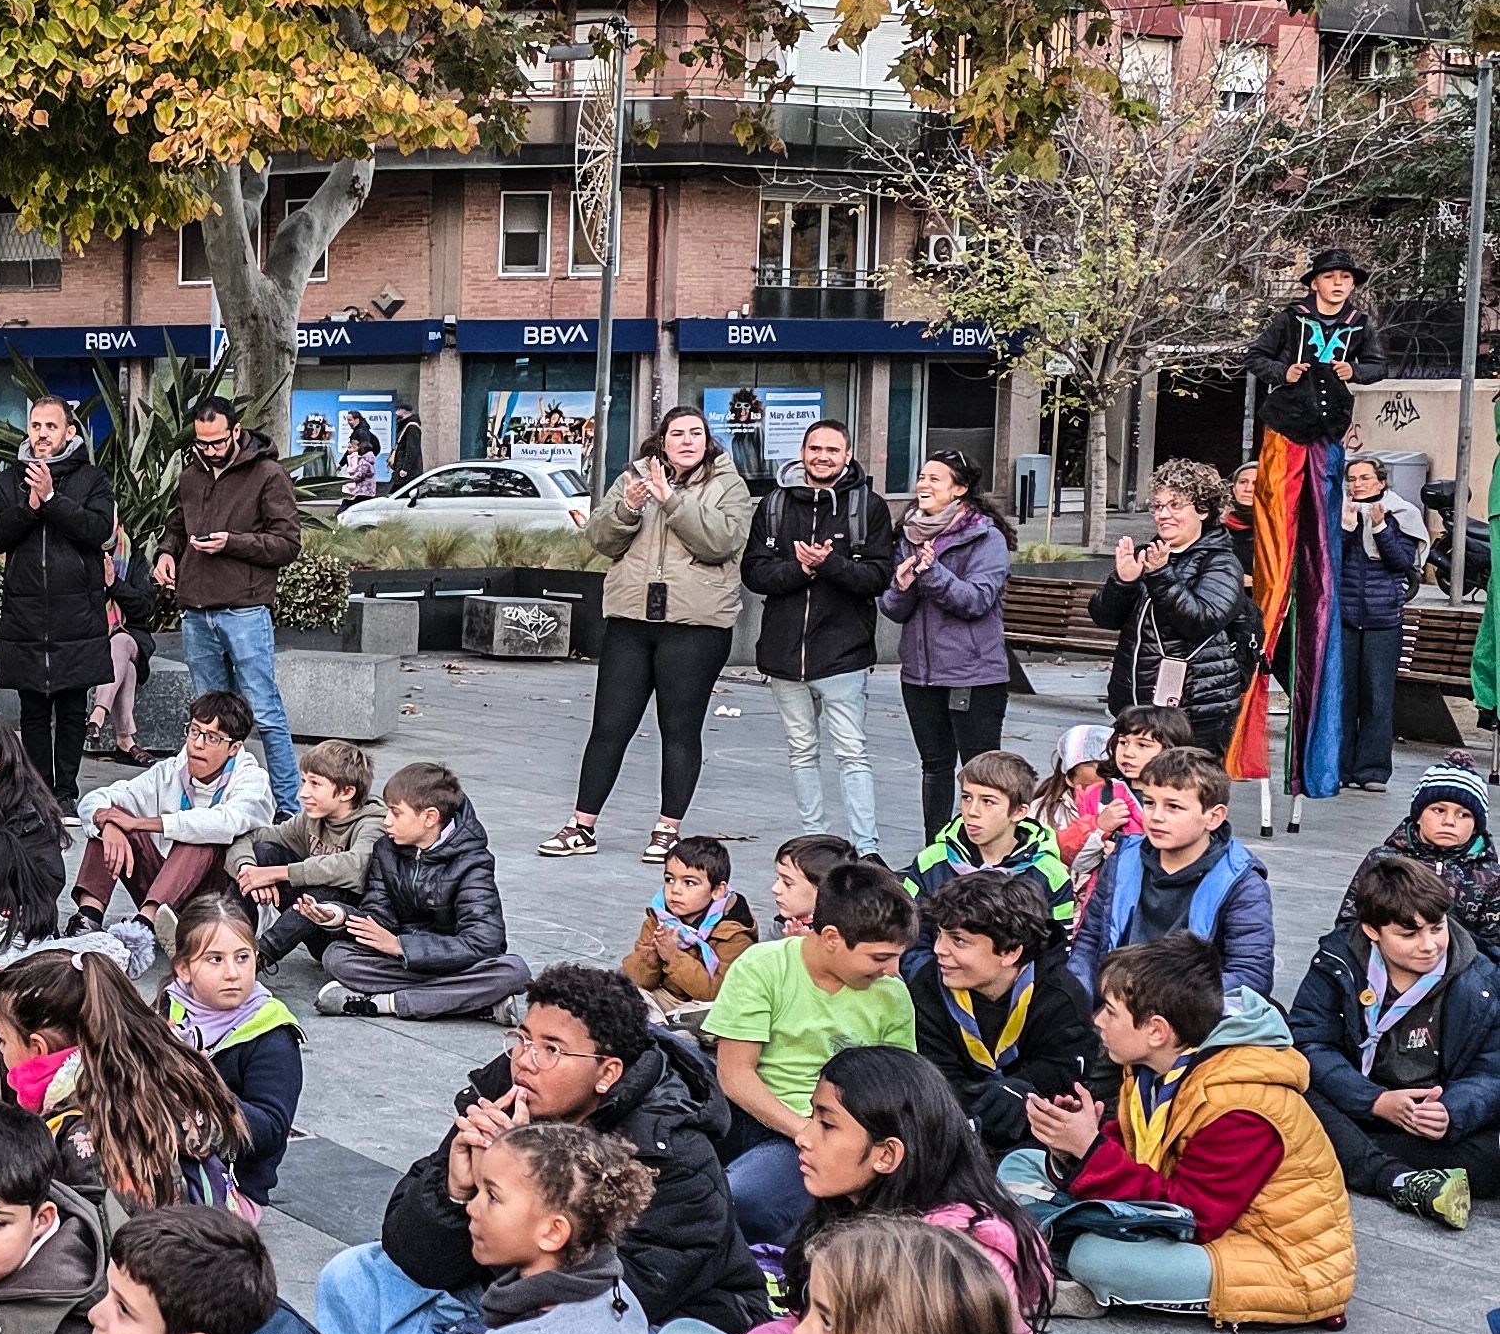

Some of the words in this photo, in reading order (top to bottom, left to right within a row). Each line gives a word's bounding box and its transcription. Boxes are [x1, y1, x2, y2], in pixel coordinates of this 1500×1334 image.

[85, 330, 137, 350] BBVA
[296, 326, 351, 347] BBVA
[523, 323, 589, 345] BBVA
[728, 324, 777, 344] BBVA
[952, 327, 997, 346] BBVA
[786, 410, 796, 420] de
[796, 410, 817, 420] BBVA
[520, 447, 538, 457] Muy
